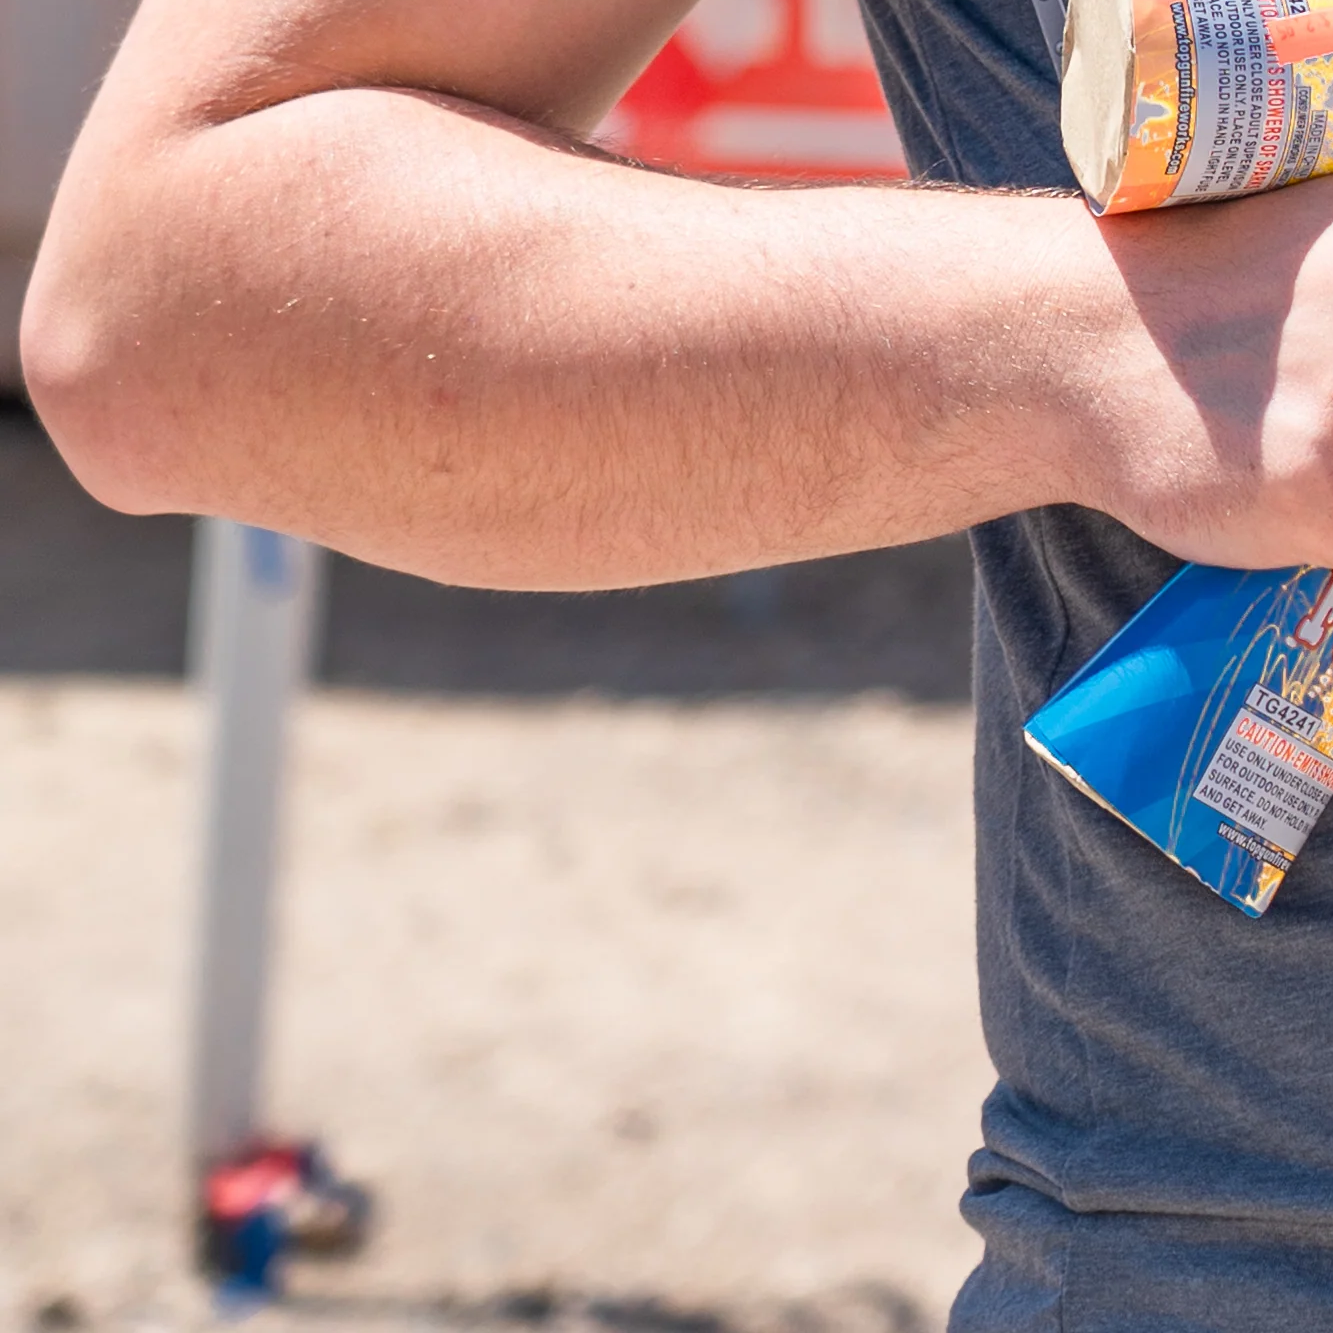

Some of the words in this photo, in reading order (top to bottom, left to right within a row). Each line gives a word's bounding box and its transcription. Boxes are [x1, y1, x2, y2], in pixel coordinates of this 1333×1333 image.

[1213, 22, 1226, 40] DO
[1245, 20, 1261, 60] UNDER
[1216, 41, 1229, 67] NOT
[1232, 47, 1246, 72] USE
[1165, 2, 1195, 175] www.topgunfireworks.com
[1218, 68, 1230, 100] HOLD
[1250, 61, 1262, 102] CLOSE
[1218, 102, 1229, 114] IN
[1247, 104, 1262, 139] ADULT
[1262, 77, 1285, 142] SHOWERS
[1229, 109, 1244, 144] PLACE
[1308, 113, 1324, 143] MADE
[1202, 150, 1221, 174] LIGHT
[1225, 146, 1239, 159] ON
[1258, 143, 1277, 157] OF
[1216, 161, 1234, 183] LEVEL
[1252, 689, 1316, 736] TG4241
[1215, 752, 1241, 774] FOR
[1236, 765, 1285, 800] OUTDOOR
[1281, 791, 1300, 808] USE
[1223, 737, 1248, 759] USE
[1245, 749, 1274, 774] ONLY
[1271, 764, 1303, 791] UNDER
[1298, 781, 1322, 802] CLOSE
[1198, 782, 1224, 805] AND
[1220, 796, 1244, 816] GET
[1240, 807, 1268, 831] AWAY.
[1206, 767, 1258, 804] SURFACE.
[1255, 795, 1271, 812] DO
[1268, 803, 1287, 821] NOT
[1283, 811, 1305, 832] HOLD
